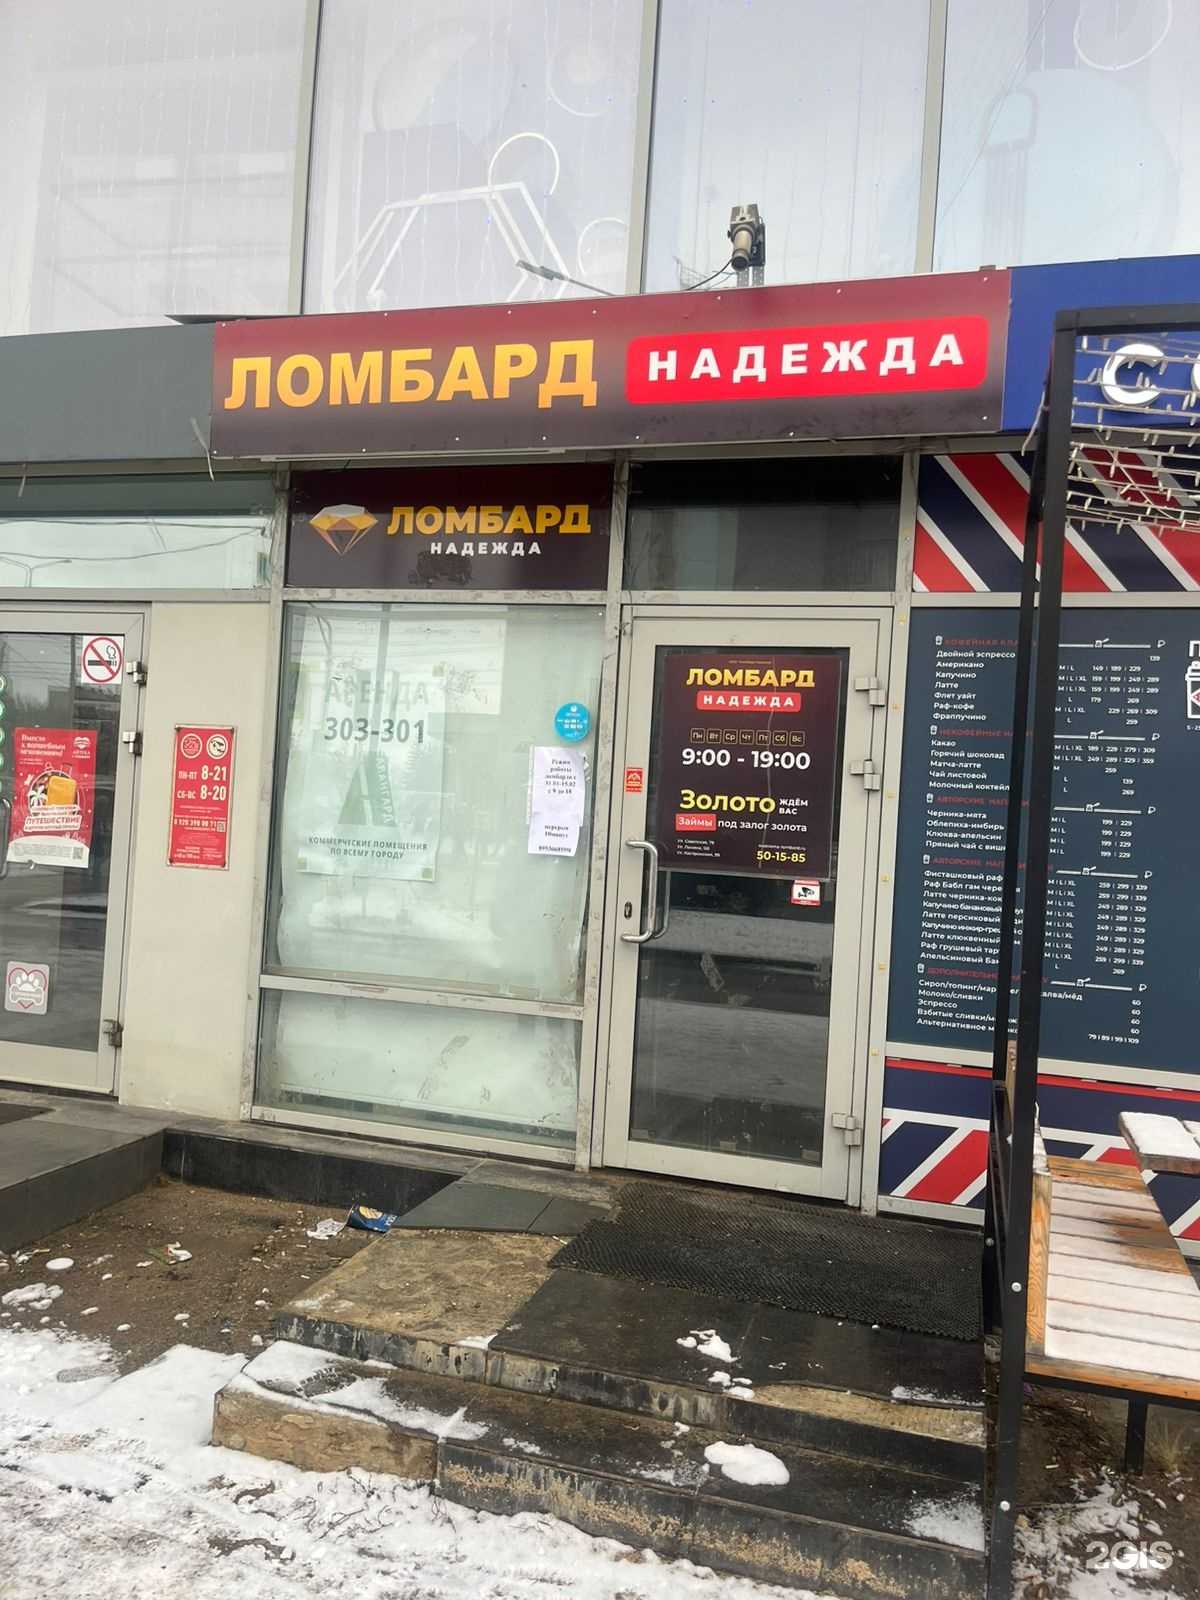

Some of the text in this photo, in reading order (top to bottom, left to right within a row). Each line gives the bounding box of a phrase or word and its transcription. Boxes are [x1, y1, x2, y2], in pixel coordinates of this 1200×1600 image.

[224, 333, 964, 410] ЛОМБАРД НАДЕЖДА
[387, 505, 591, 535] ЛОМБАРД
[430, 541, 541, 557] НАДЕЖДА
[936, 650, 1016, 660] Двойной эспрессо
[936, 661, 984, 669] Американо
[686, 668, 816, 688] ЛОМБАРД
[935, 671, 977, 680] Капучино
[703, 695, 794, 708] НАДЕЖДА
[934, 692, 977, 701] Флет уайт
[933, 702, 975, 711] Раф-кофе
[932, 712, 987, 721] Фраппучино
[324, 717, 425, 743] 303-301
[692, 731, 802, 743] Пн Вт Ср Чт Пт Сб Вс
[931, 739, 957, 748] Какао
[682, 748, 731, 767] 9:00
[751, 750, 811, 770] 19:00
[930, 750, 1006, 761] Горячий шоколад
[930, 760, 983, 769] Матча-латте
[178, 765, 227, 781] ПН-ПТ 8-21
[929, 770, 988, 780] Чай листовой
[929, 781, 974, 790] Молочный
[177, 785, 227, 801] СБ-ВС 8-20
[680, 789, 776, 814] Золото
[779, 808, 798, 816] ВАС
[927, 810, 987, 820] Черника-мята
[678, 816, 807, 832] Займы под залог золота
[926, 820, 1005, 831] Облепиха-имбирь
[926, 830, 1002, 841] Клюква-апельсин
[308, 837, 428, 851] КОММЕРЧЕСКИЕ ПОМЕЩЕНИЯ
[925, 840, 960, 850] Пряный
[961, 842, 977, 851] чай
[330, 847, 404, 860] ПО ВСЕМУ ГОРОДУ
[756, 850, 806, 863] 50-15-85
[924, 870, 1003, 883] Фисташковый раф
[923, 880, 941, 889] Раф
[942, 880, 963, 890] Бабл
[965, 883, 980, 891] гам
[923, 890, 948, 899] Латте
[922, 900, 1003, 913] Капучино банановый
[922, 910, 1001, 924] Латте персиковый
[921, 920, 957, 931] Капучино
[920, 931, 945, 940] Латте
[920, 941, 938, 951] Раф
[939, 943, 983, 954] грушевый
[919, 951, 983, 963] Апельсиновый
[917, 988, 985, 1001] Молоко/сливки
[917, 998, 959, 1009] Эспрессо
[917, 1007, 955, 1019] Взбитые
[916, 1017, 987, 1033] Альтернативное
